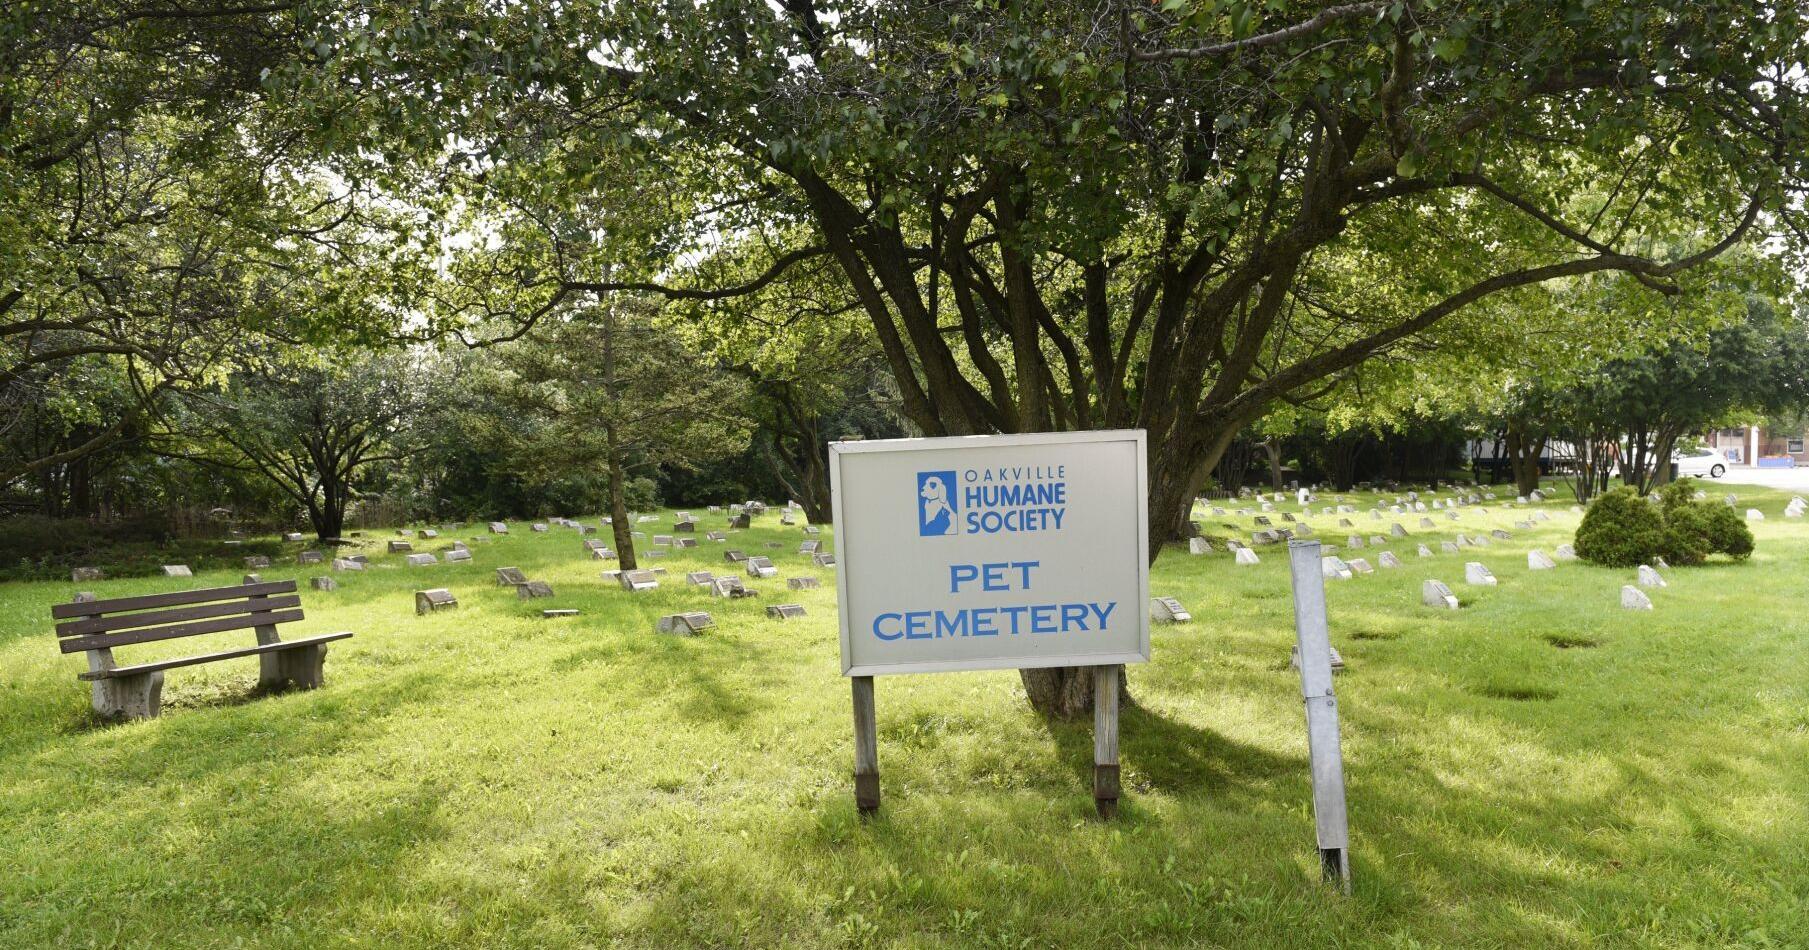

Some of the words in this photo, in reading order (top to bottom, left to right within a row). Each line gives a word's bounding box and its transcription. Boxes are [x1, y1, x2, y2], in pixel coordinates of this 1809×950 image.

[965, 465, 1065, 482] OAKVILLE
[965, 482, 1065, 508] HUMANE
[966, 507, 1065, 534] SOCIETY
[949, 560, 1040, 593] PET
[872, 602, 1117, 641] CEMETERY
